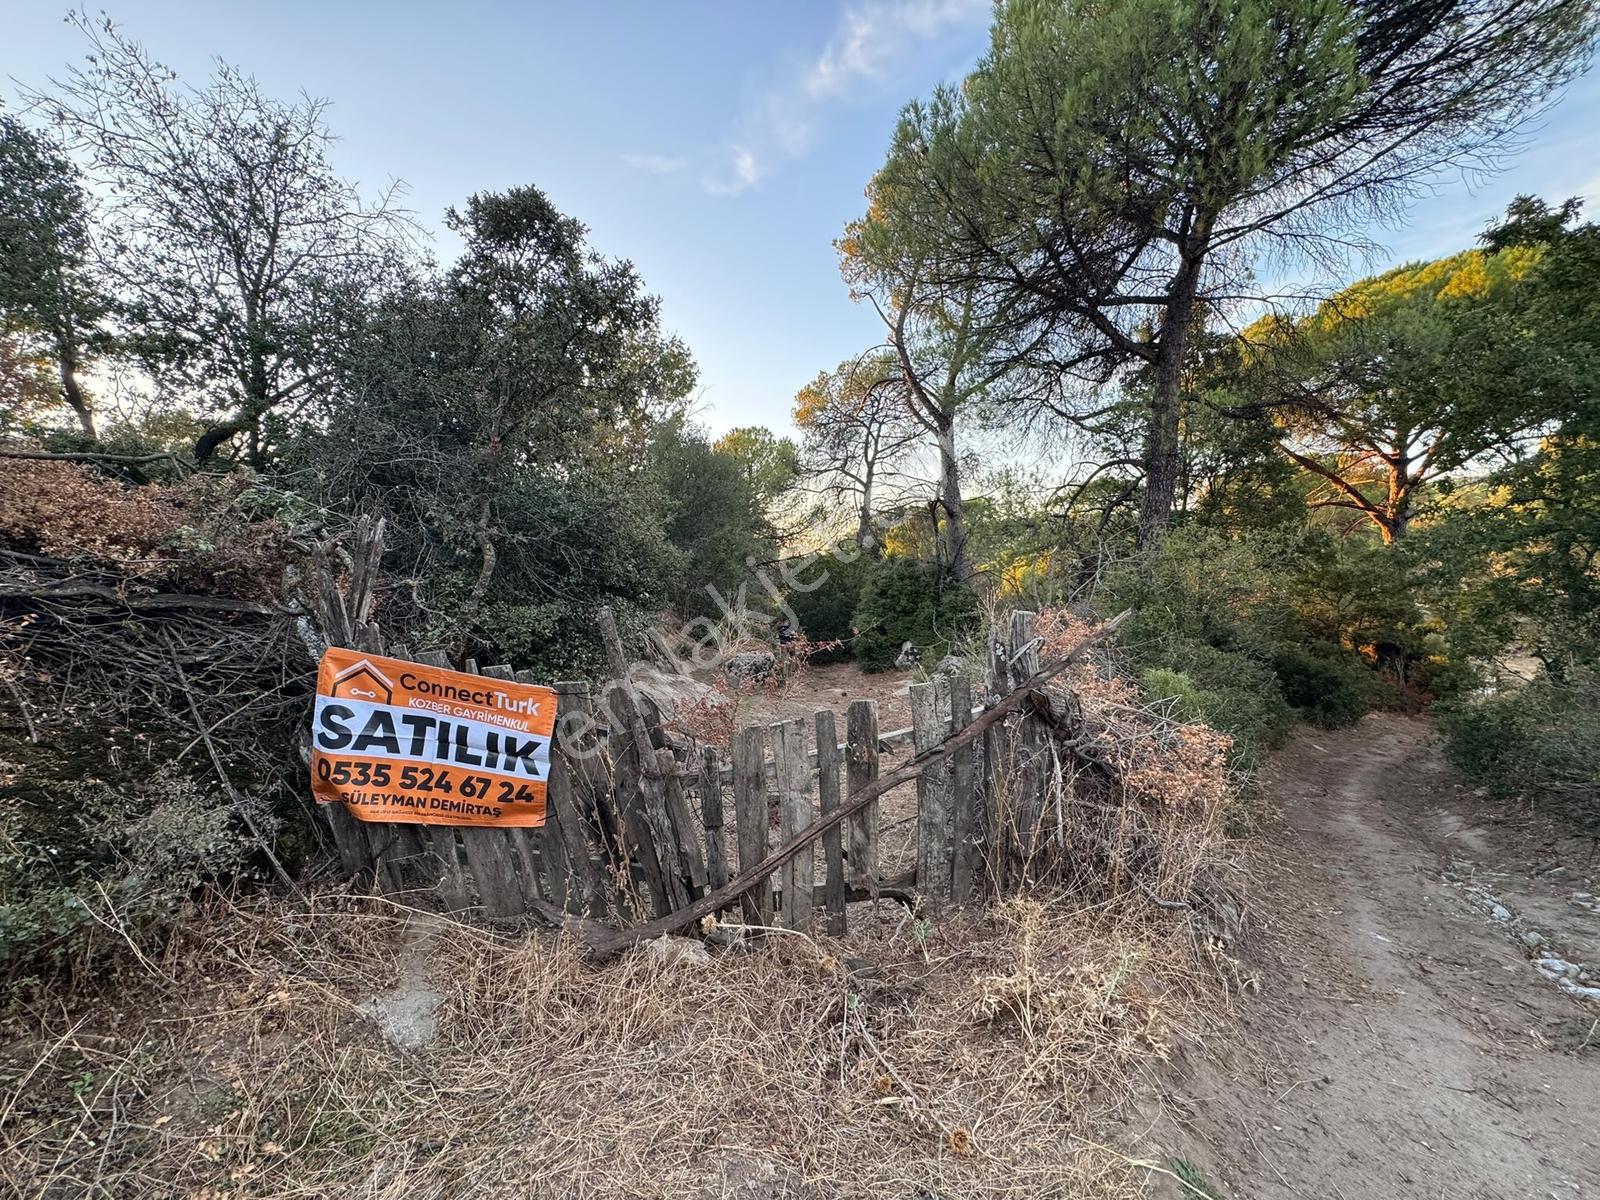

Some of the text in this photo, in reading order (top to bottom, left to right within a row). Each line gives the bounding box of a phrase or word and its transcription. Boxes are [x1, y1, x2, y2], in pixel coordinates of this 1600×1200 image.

[400, 673, 540, 716] ConnectTurk
[408, 697, 530, 732] KOZBER GAYRİMENKUL
[317, 704, 542, 776] SATILIK
[317, 758, 534, 803] 0535 524 67 24
[342, 791, 427, 809] SÜLEYMAN
[430, 798, 502, 818] DEMİRTAŞ
